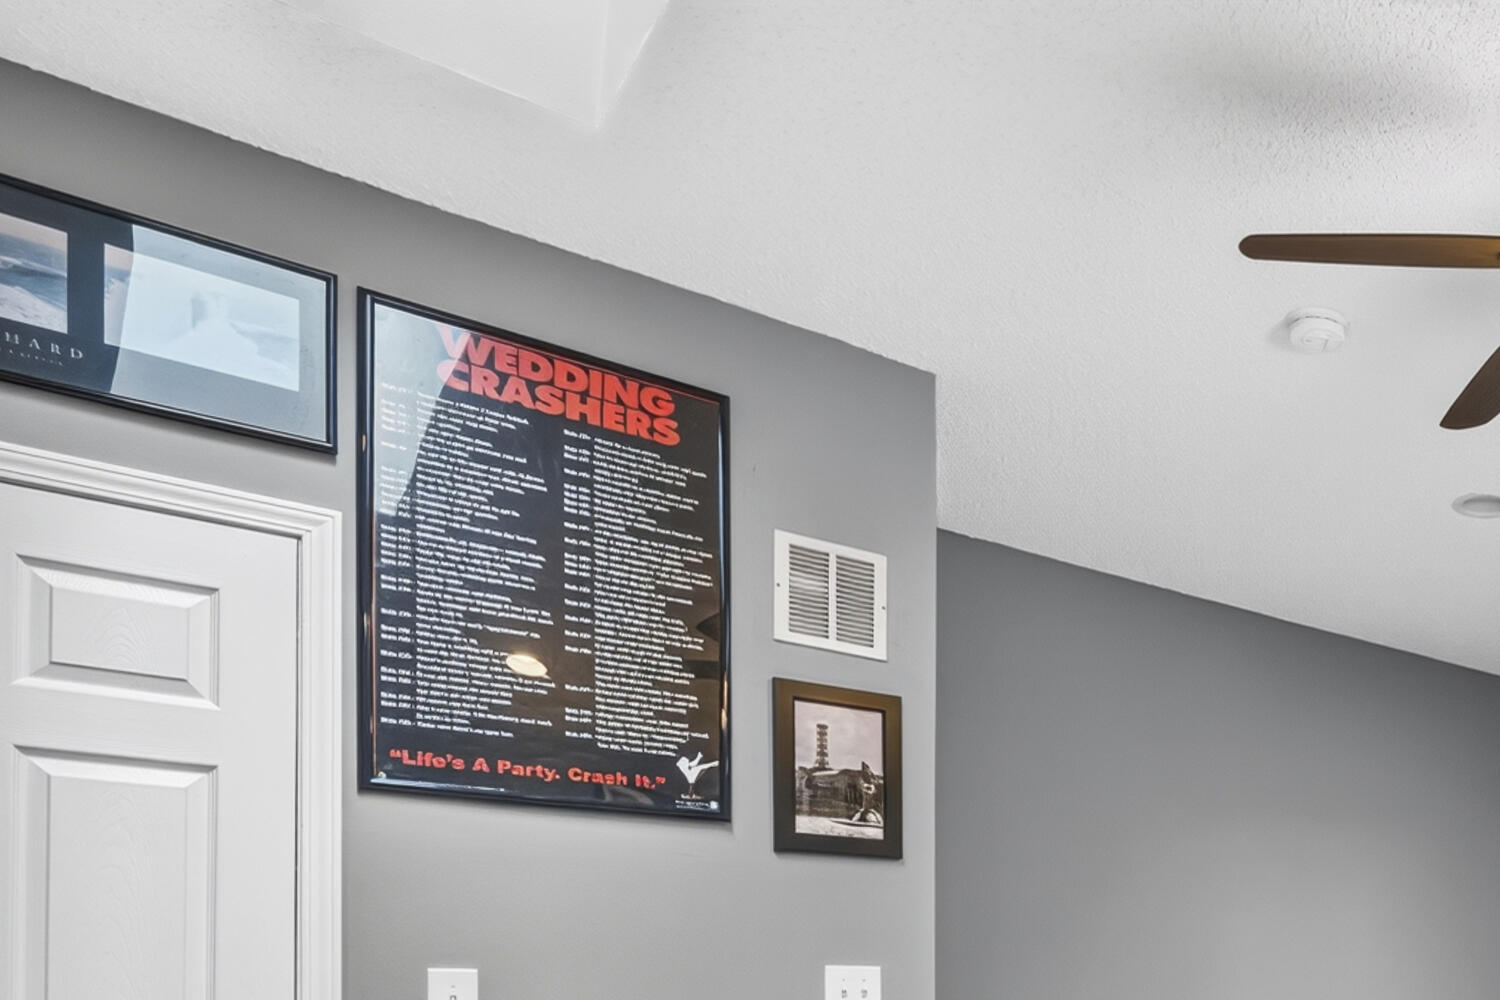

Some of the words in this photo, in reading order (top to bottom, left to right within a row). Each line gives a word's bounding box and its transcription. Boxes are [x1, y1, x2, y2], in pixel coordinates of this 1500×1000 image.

[437, 359, 680, 446] CRASHERS
[438, 324, 676, 418] WEDDING
[472, 757, 490, 773] A
[497, 760, 560, 782] Party.
[568, 767, 628, 785] Crash
